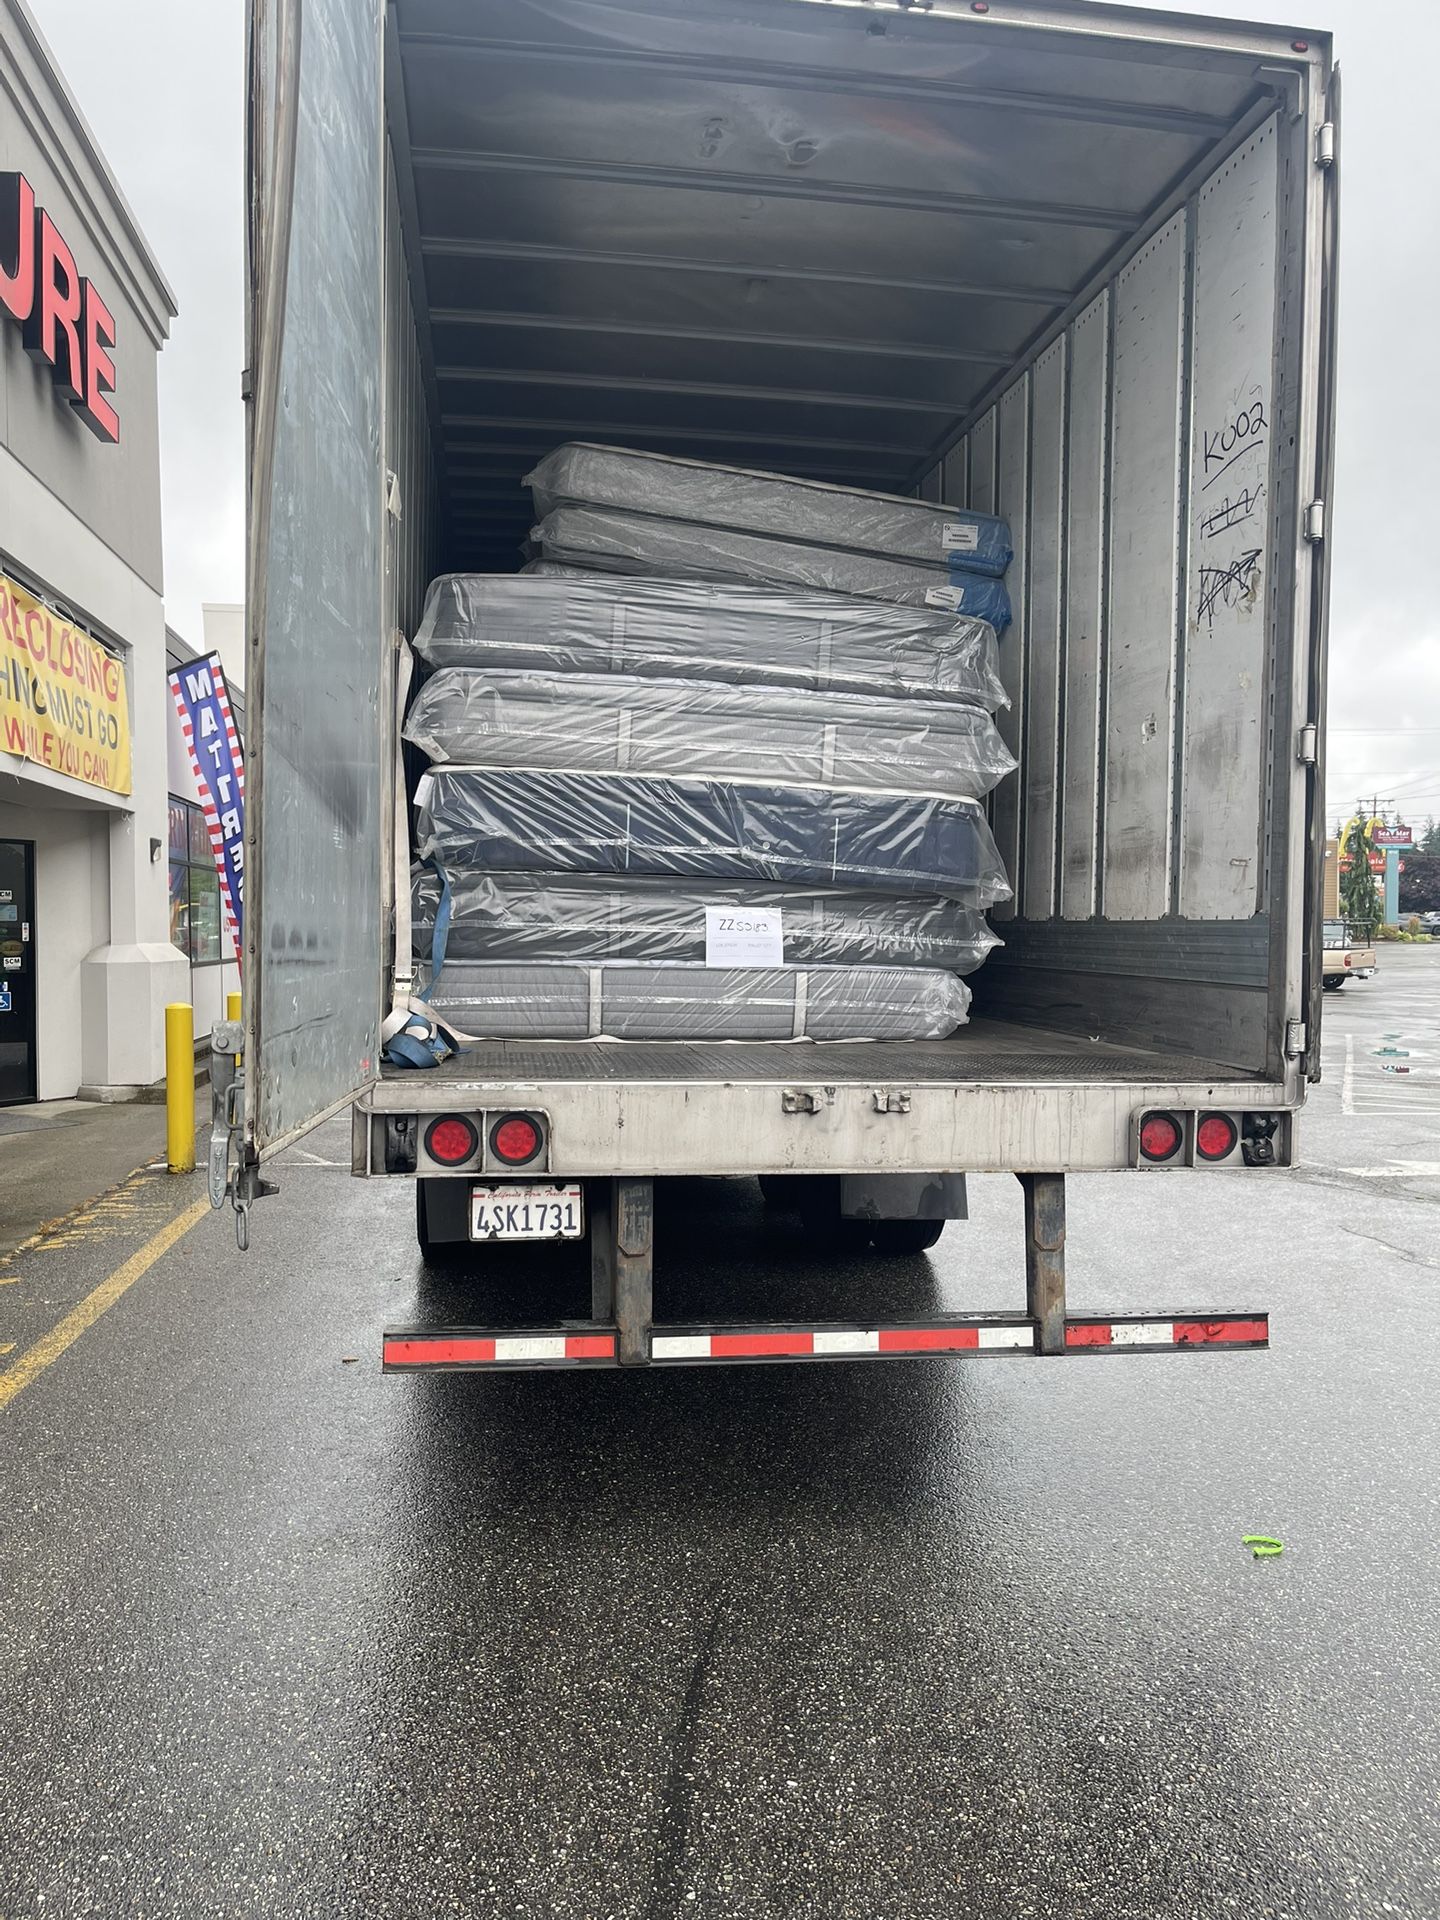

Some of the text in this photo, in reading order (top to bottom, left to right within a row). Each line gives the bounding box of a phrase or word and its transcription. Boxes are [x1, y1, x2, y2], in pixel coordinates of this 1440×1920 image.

[46, 680, 92, 738] MUST
[97, 708, 118, 750] GO
[58, 737, 80, 776] YOU
[83, 750, 110, 786] CAN!
[477, 1203, 577, 1232] 4SK1731
